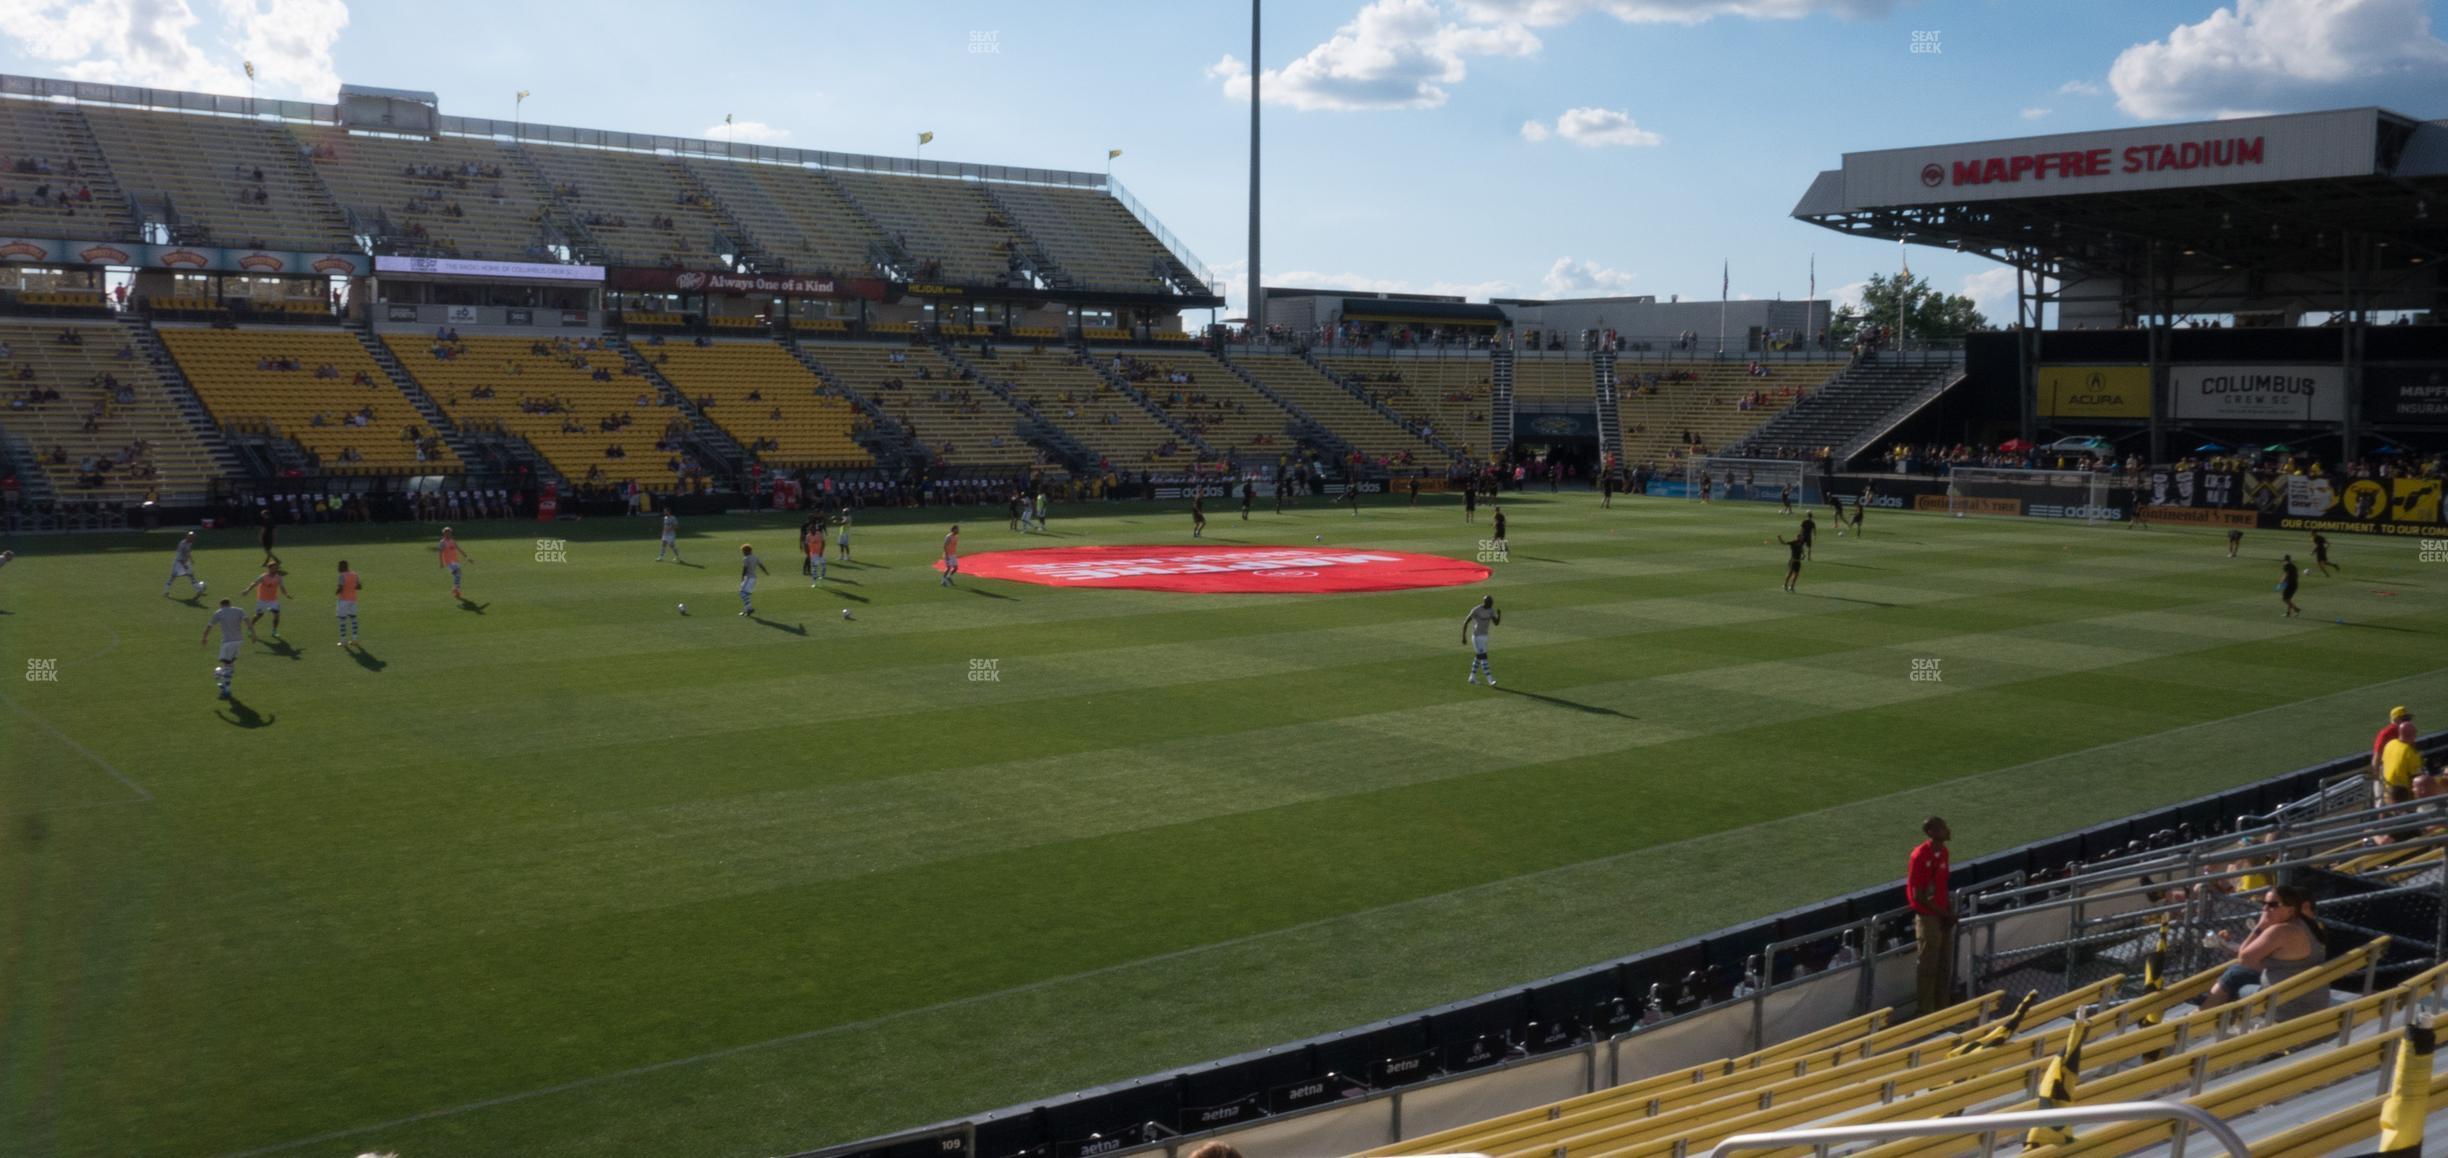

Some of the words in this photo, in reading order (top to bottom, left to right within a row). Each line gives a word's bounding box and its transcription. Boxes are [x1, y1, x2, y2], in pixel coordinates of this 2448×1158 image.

[1952, 149, 2111, 186] MAPFRE
[2122, 136, 2264, 173] STADIUM
[708, 275, 754, 291] Always
[757, 278, 779, 289] One
[781, 278, 794, 290] of
[795, 282, 803, 290] a
[805, 280, 834, 293] Kind
[2202, 375, 2315, 396] COLUMBUS
[2068, 395, 2124, 405] ACURA
[2224, 394, 2265, 404] CREW
[2272, 395, 2289, 404] SC
[1183, 484, 1225, 497] addas
[1346, 481, 1381, 492] aidas
[2224, 513, 2254, 525] TIRE
[2281, 519, 2303, 529] OUR
[2381, 523, 2396, 533] TO
[2396, 524, 2420, 535] OUR
[1544, 1031, 1567, 1044] ACURA
[1465, 1051, 1491, 1064] ACURA
[1386, 1057, 1420, 1075] aetna
[1289, 1083, 1324, 1100] aetna
[1201, 1105, 1240, 1121] aetna
[942, 1139, 961, 1151] 109
[1080, 1138, 1121, 1156] aetna
